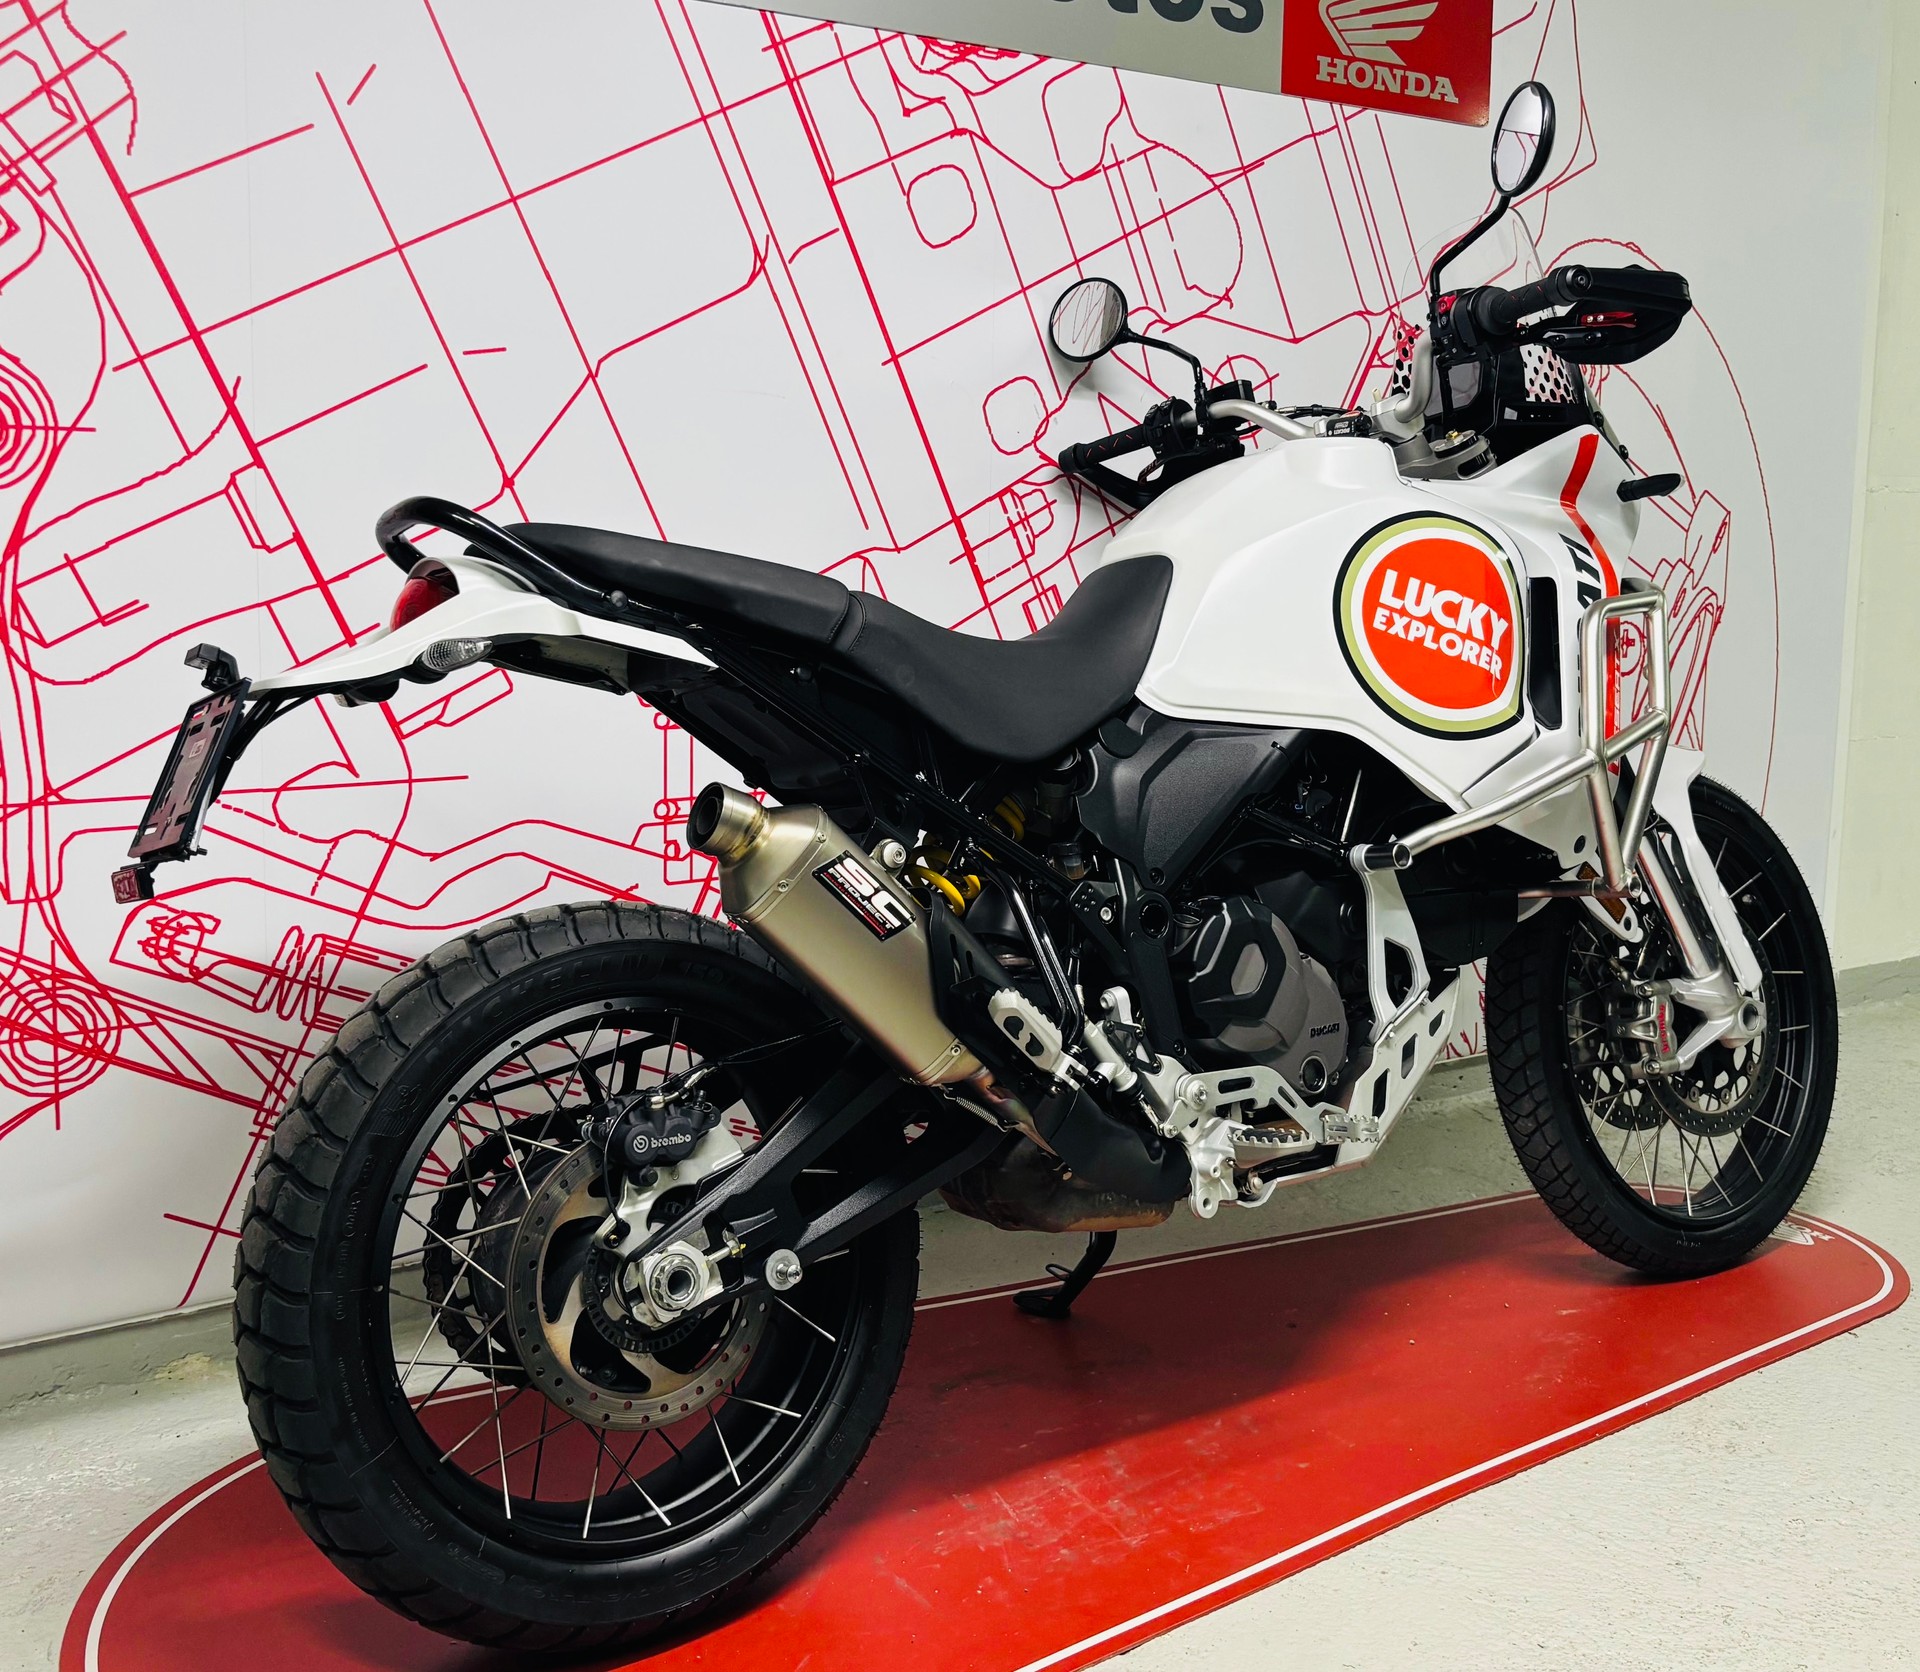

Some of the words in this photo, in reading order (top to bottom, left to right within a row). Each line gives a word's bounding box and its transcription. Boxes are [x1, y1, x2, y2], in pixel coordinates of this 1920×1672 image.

[1316, 55, 1459, 104] HONDA
[1379, 568, 1509, 651] LUCKY
[1373, 606, 1503, 680] EXPLORER
[827, 867, 895, 930] PROJECT
[834, 857, 912, 928] SC
[1309, 1022, 1340, 1038] DUCATI
[650, 1132, 692, 1148] brembo
